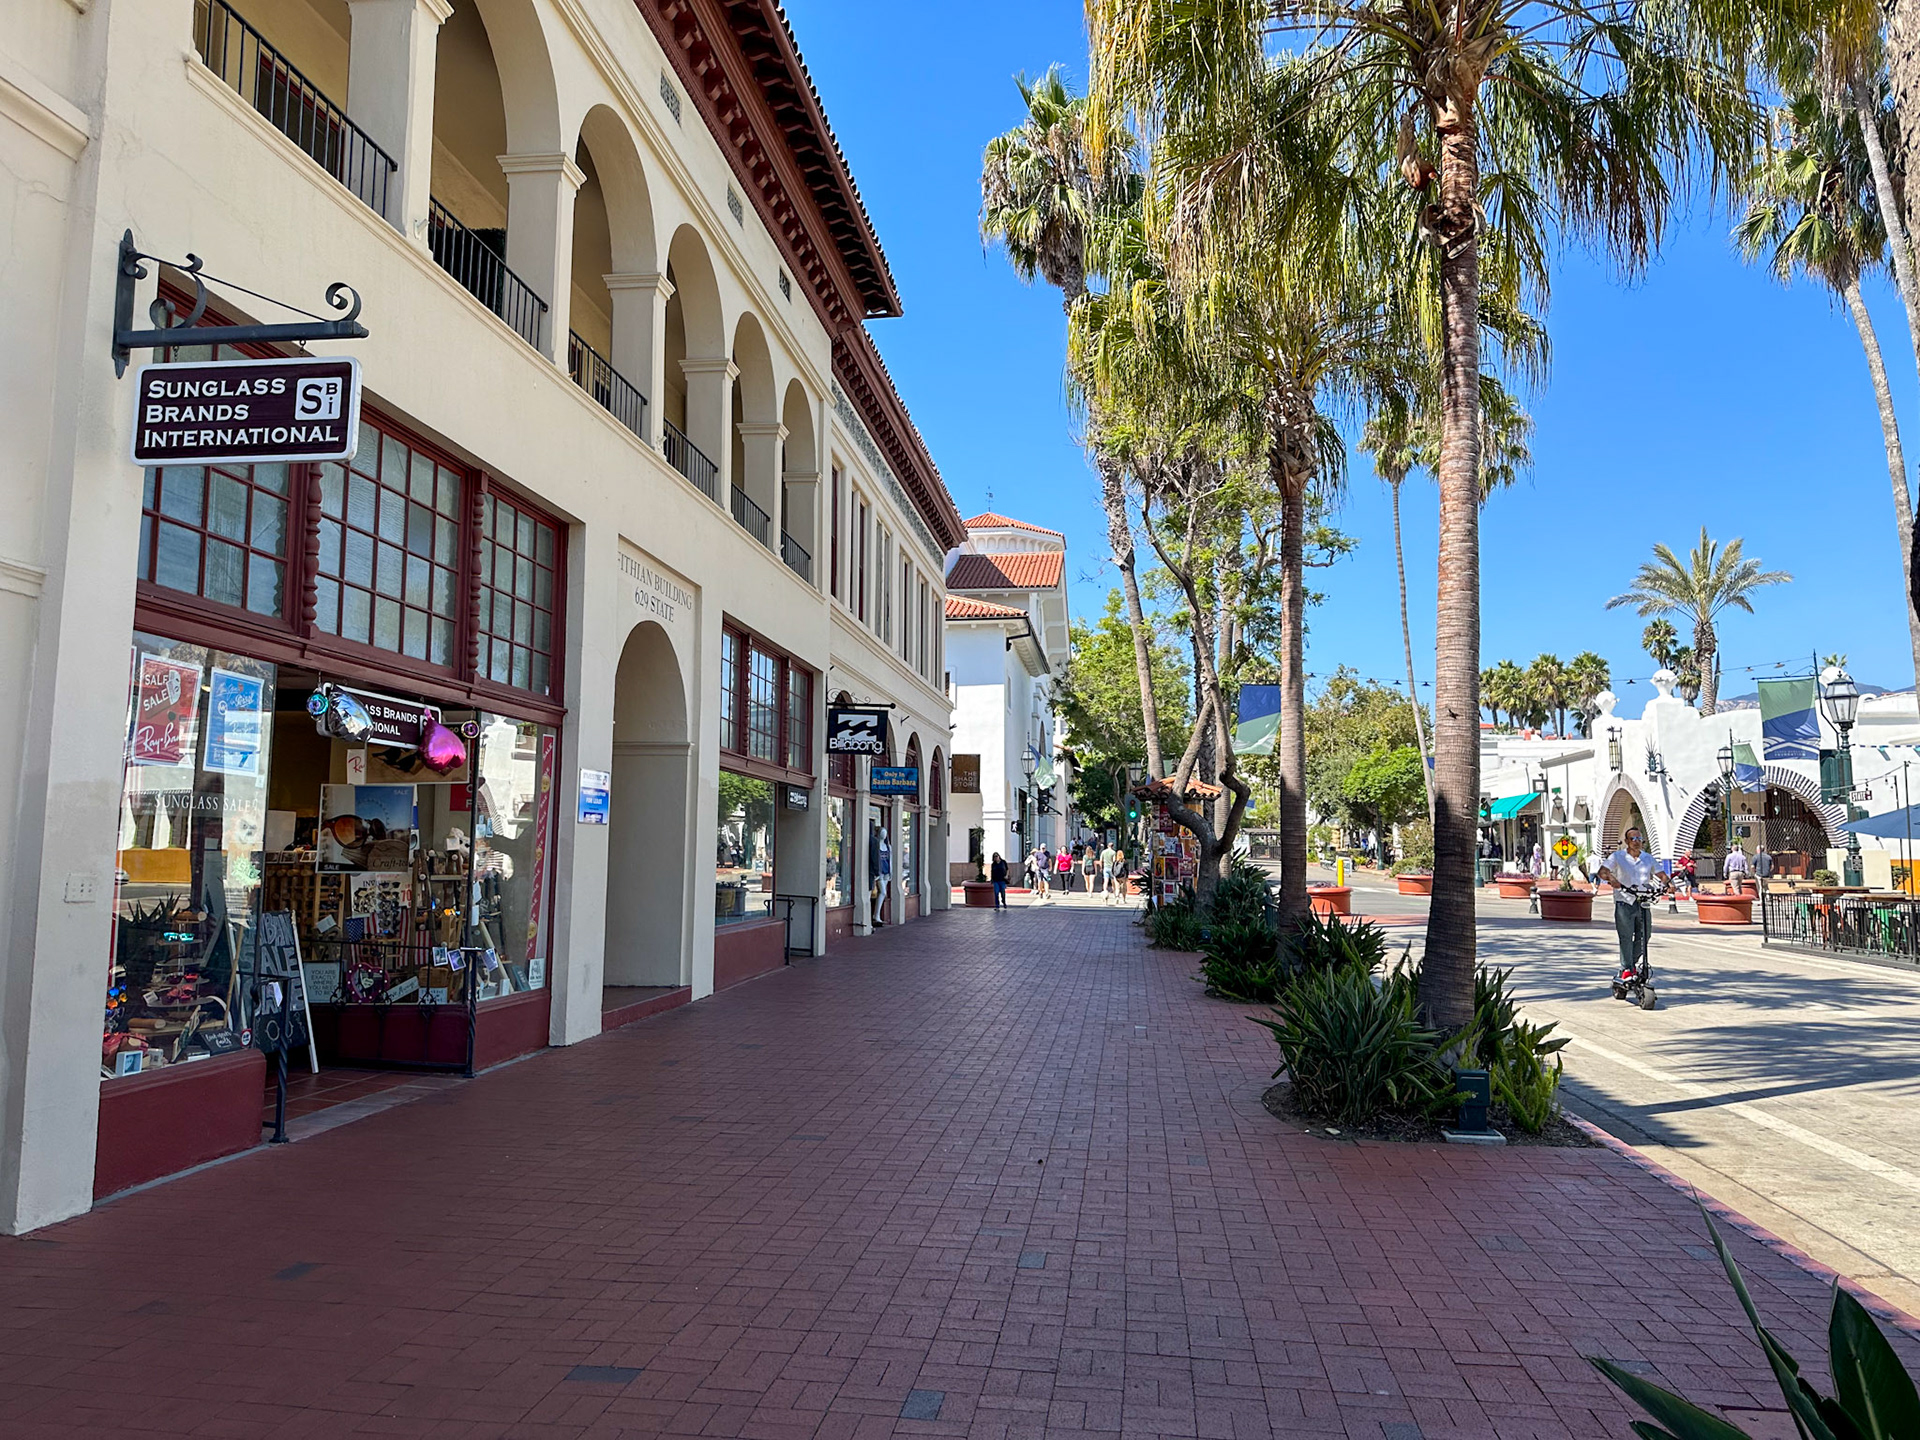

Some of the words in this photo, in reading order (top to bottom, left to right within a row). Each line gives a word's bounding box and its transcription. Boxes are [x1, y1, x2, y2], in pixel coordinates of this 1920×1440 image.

[148, 378, 286, 398] SUNGLASS
[145, 404, 249, 423] BRANDS
[144, 426, 339, 448] INTERNATIONAL
[655, 574, 692, 610] BUILDING
[635, 587, 649, 609] 629
[651, 596, 674, 623] STATE
[145, 674, 169, 685] SALE
[143, 689, 169, 711] SALE
[364, 704, 381, 717] ASS
[384, 707, 418, 723] BRANDS
[373, 722, 400, 735] IONAL
[830, 737, 884, 754] Billabong
[154, 793, 218, 810] SUNGLASS
[1852, 791, 1866, 801] STATE
